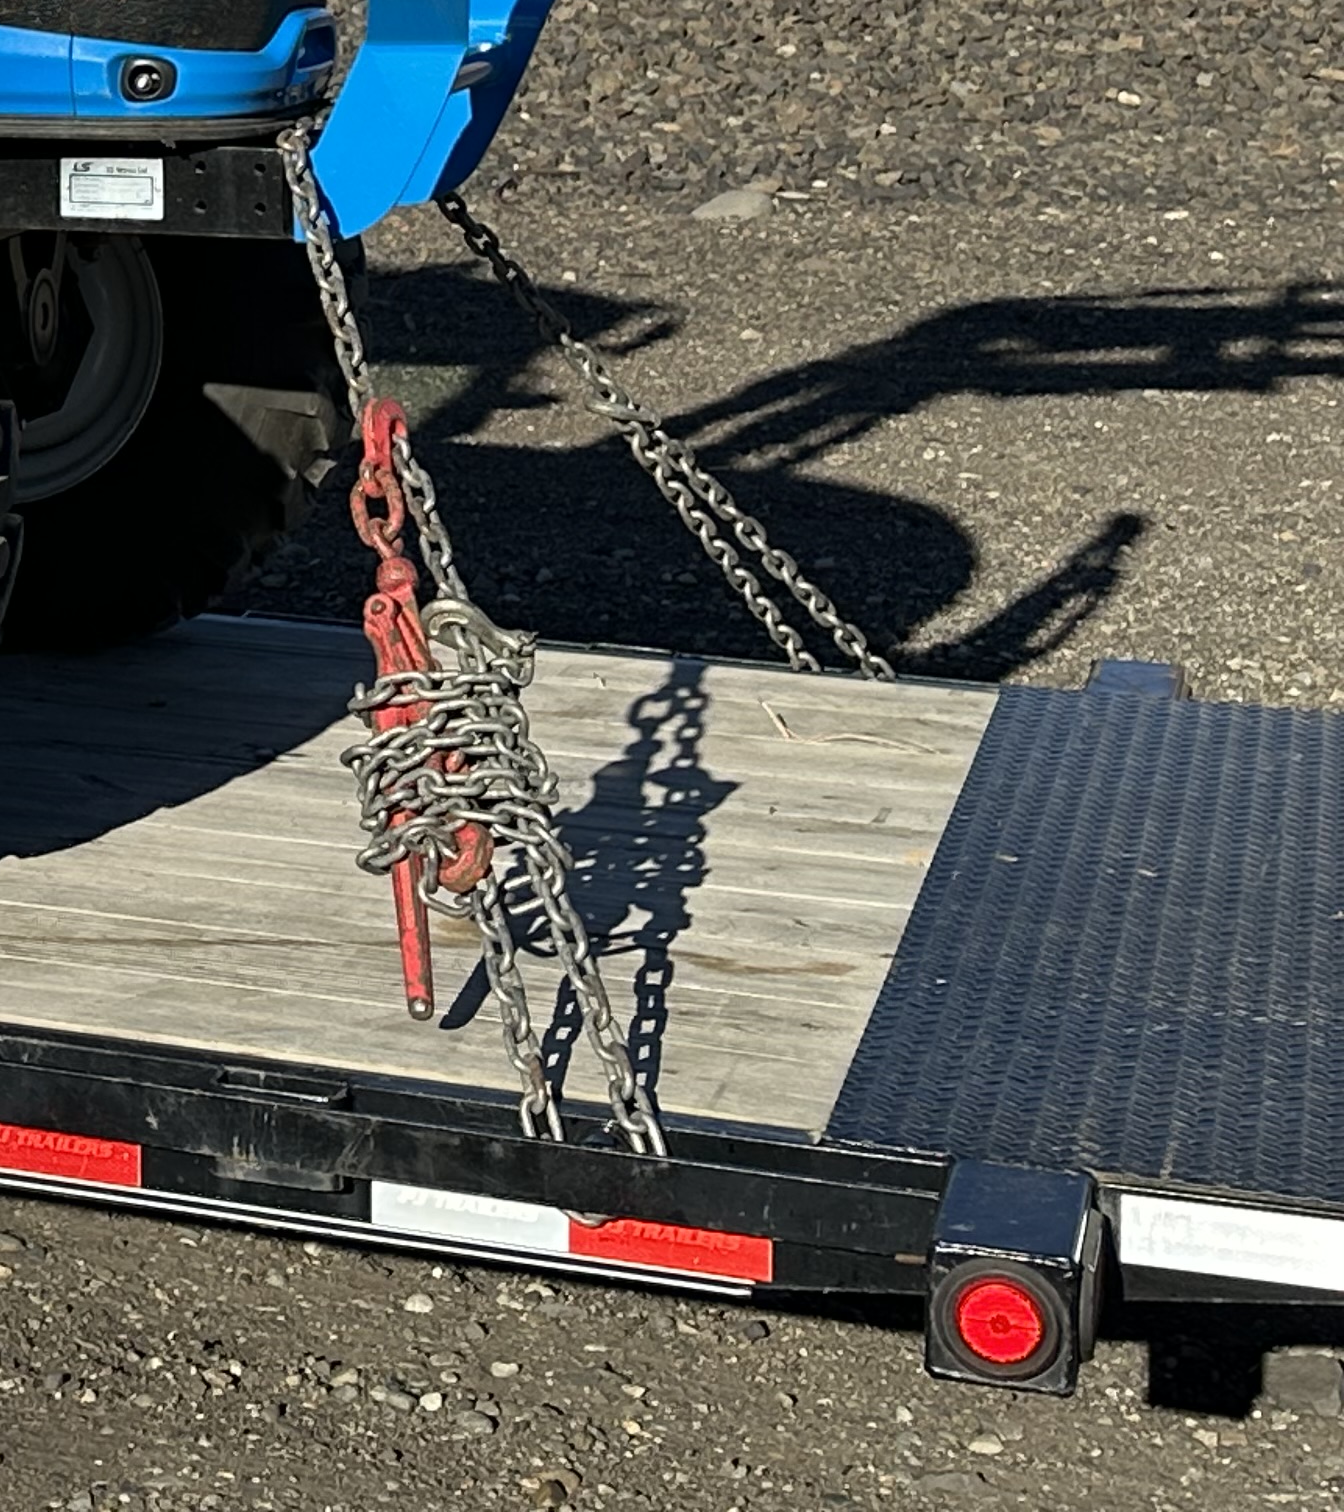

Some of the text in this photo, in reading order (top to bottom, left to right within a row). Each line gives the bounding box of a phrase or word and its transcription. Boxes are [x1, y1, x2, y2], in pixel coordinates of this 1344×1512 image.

[17, 1131, 114, 1159] TRAILERS
[434, 1194, 540, 1223] TRAILERS
[632, 1222, 742, 1251] TRAILERS
